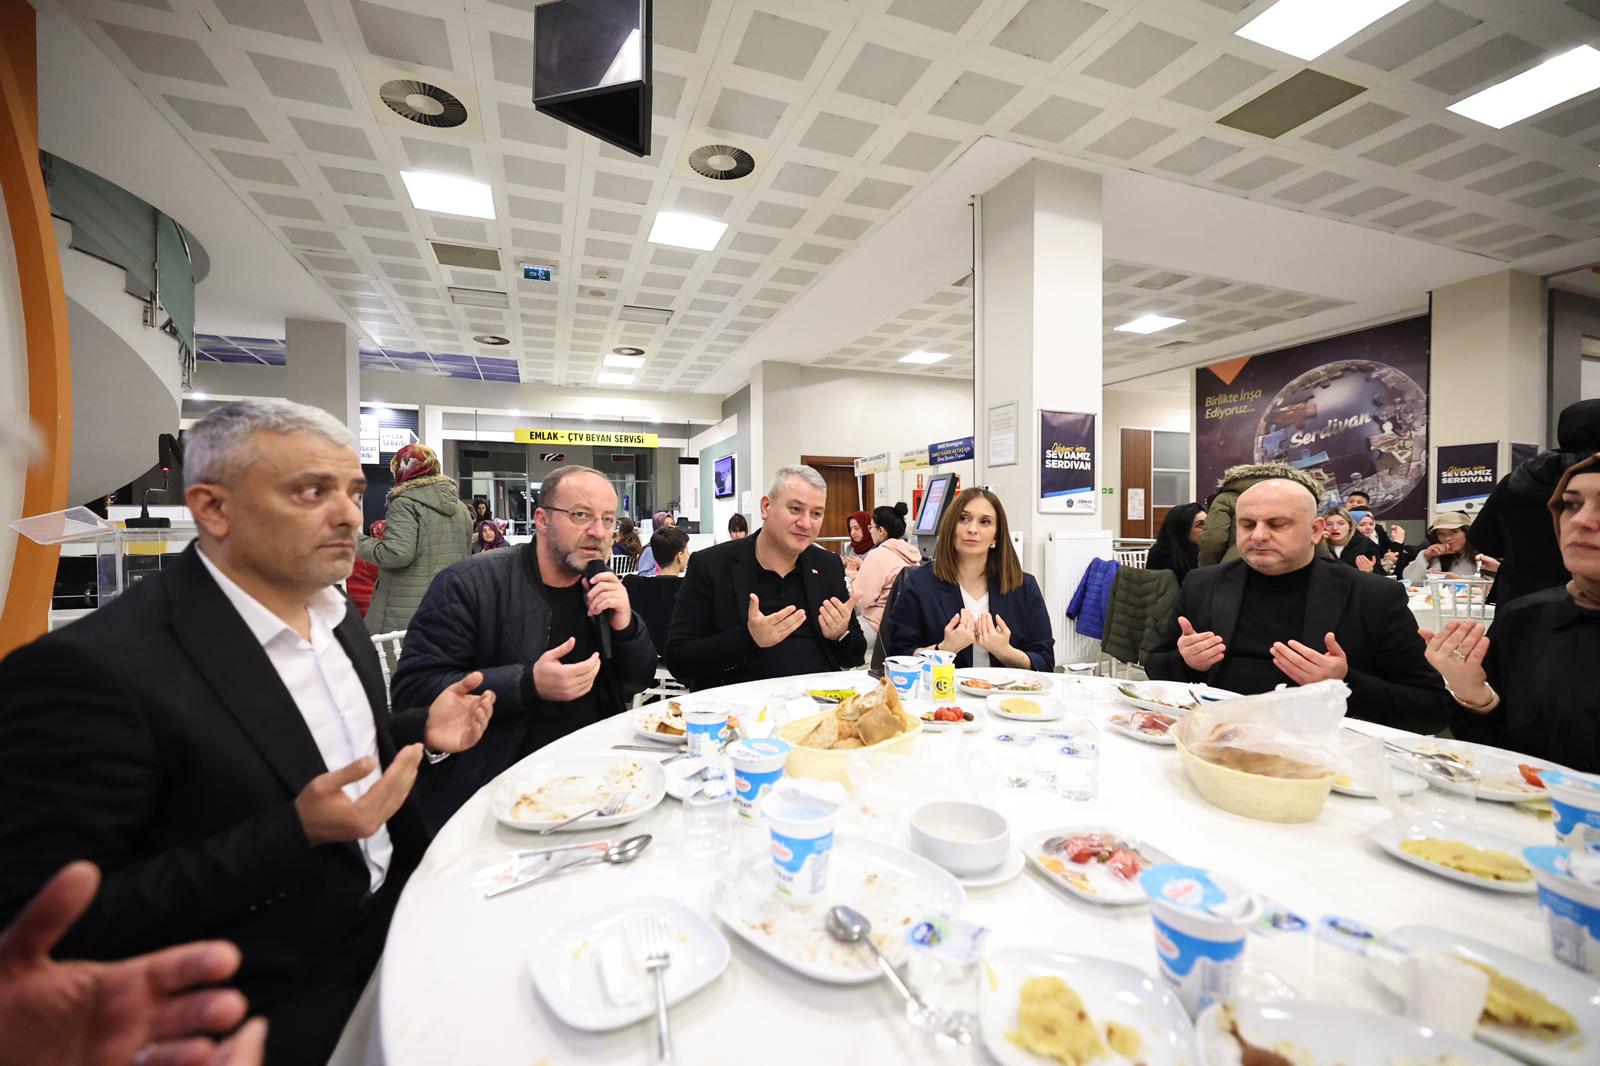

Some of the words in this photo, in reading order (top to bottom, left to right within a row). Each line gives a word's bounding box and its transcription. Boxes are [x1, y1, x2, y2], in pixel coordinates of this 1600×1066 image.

[1205, 393, 1239, 408] Birlikte
[1289, 411, 1372, 448] Serdivan
[529, 431, 559, 441] EMLAK
[568, 432, 584, 443] ÇTV
[585, 433, 612, 443] BEYAN
[1045, 449, 1091, 461] SEVDAMIZ
[1441, 469, 1492, 478] SEVDAMIZ
